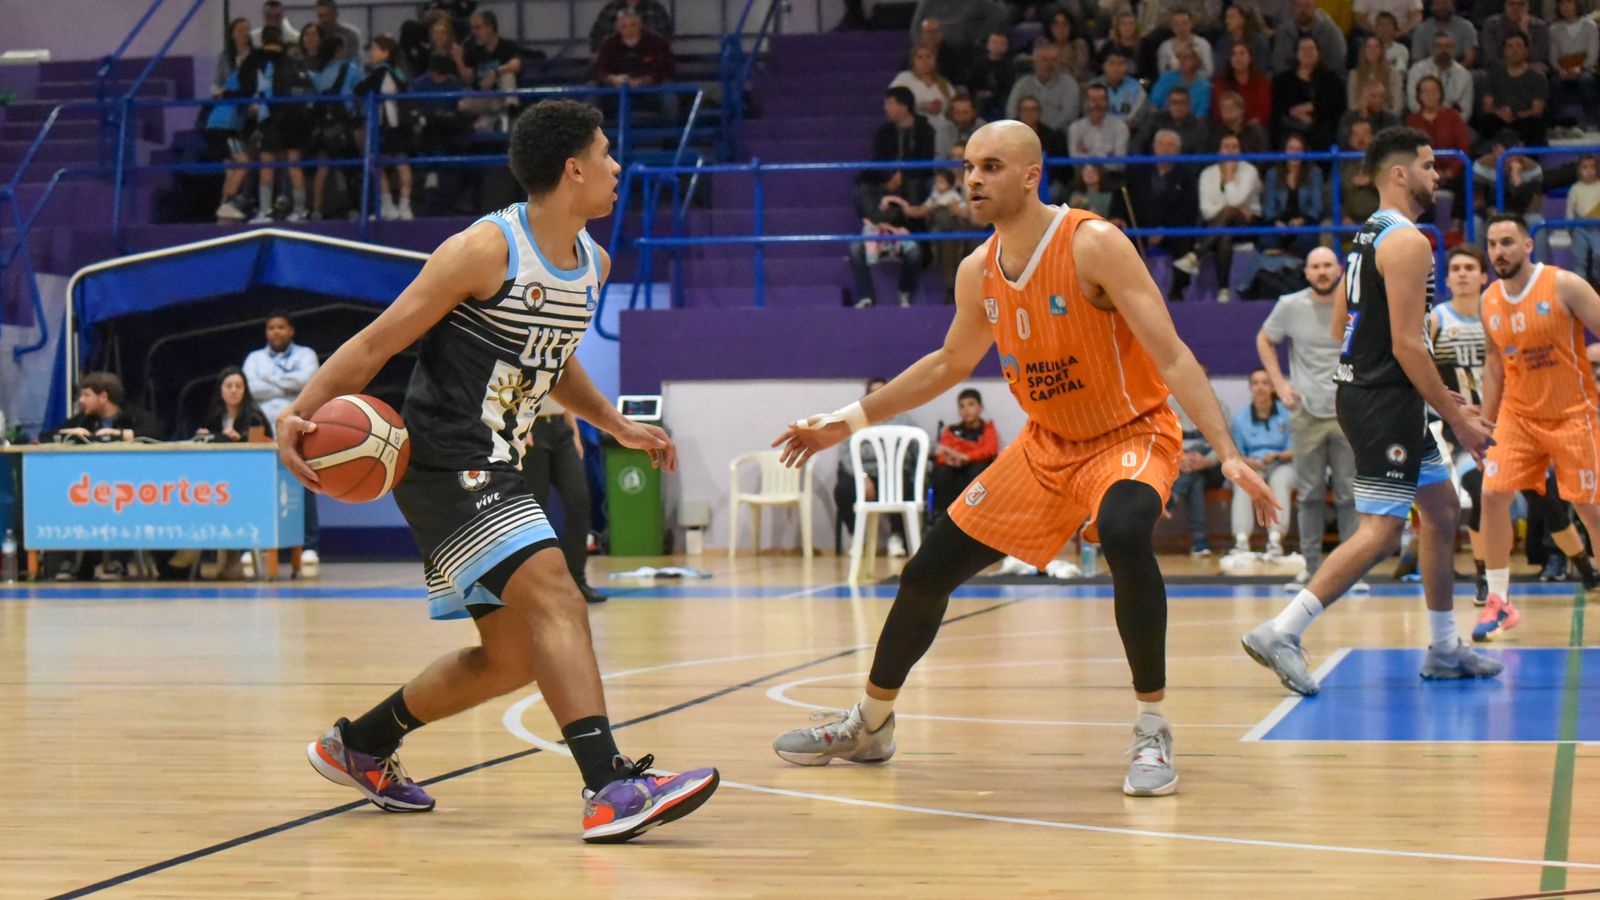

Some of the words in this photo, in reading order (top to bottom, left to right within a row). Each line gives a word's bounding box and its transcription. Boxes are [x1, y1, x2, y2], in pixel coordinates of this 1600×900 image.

[1016, 308, 1031, 339] 0
[1510, 311, 1526, 334] 13
[1026, 356, 1078, 374] MELILLA
[1028, 369, 1069, 388] SPORT
[1030, 379, 1085, 401] CAPITAL
[1121, 451, 1137, 467] 0
[69, 473, 231, 513] deportes
[475, 491, 501, 511] vive
